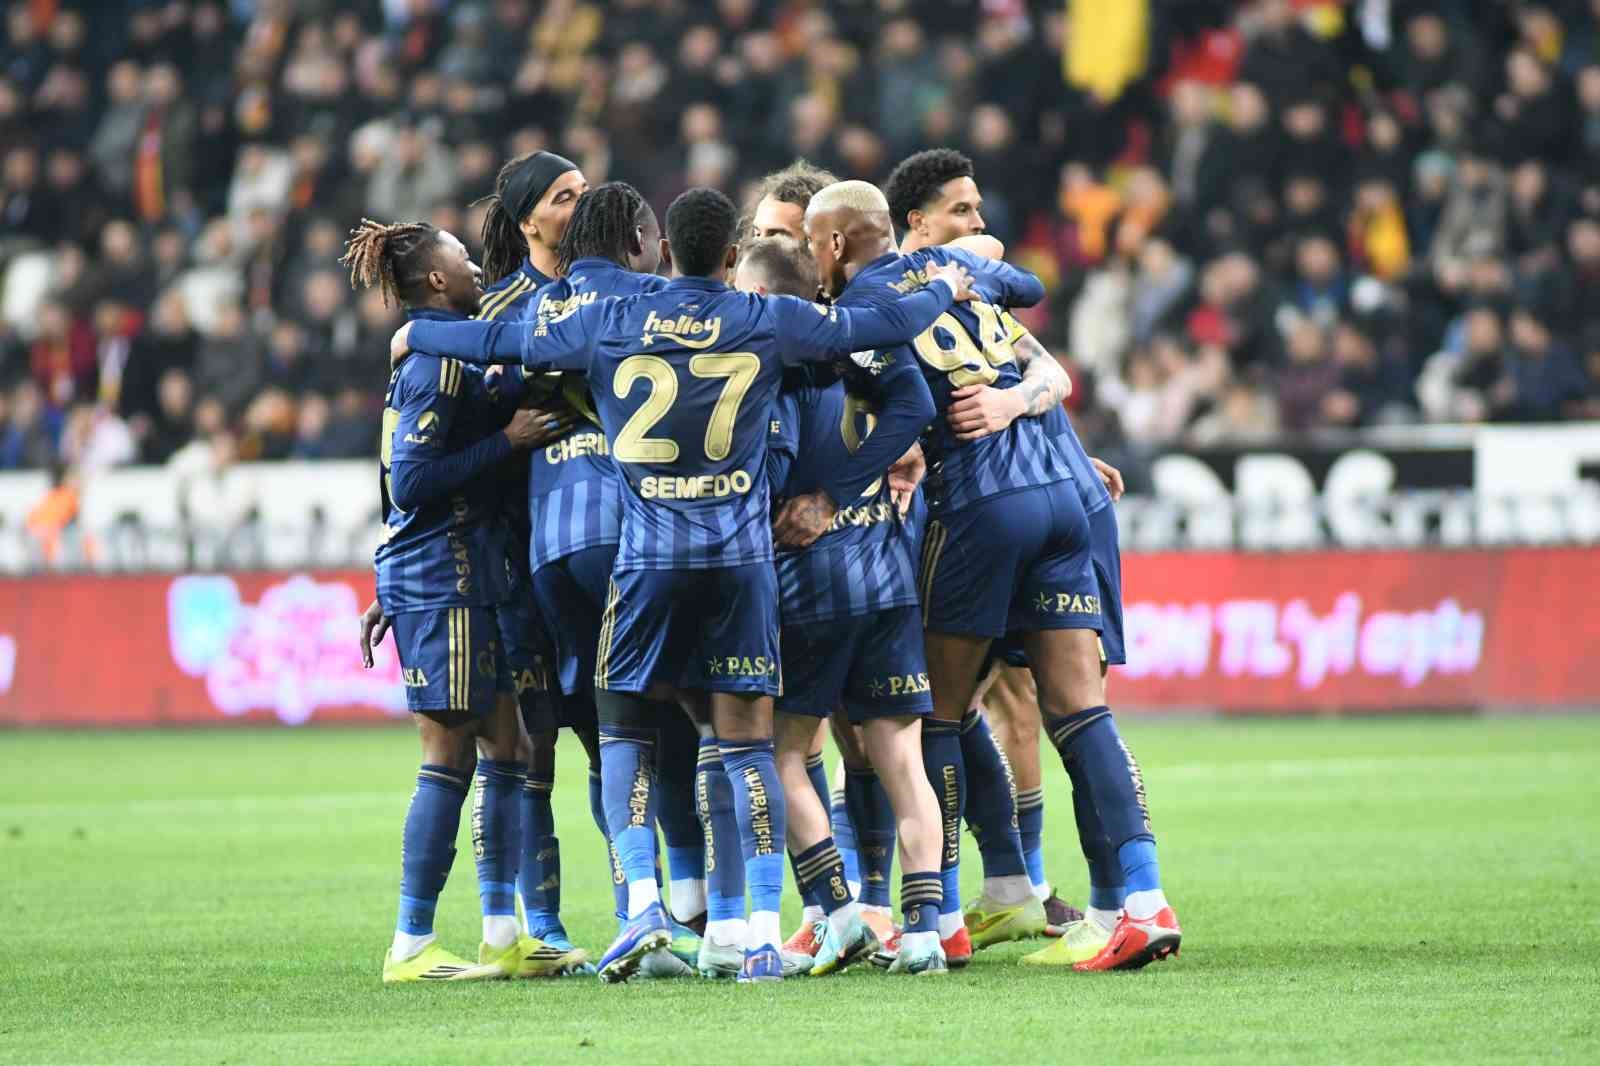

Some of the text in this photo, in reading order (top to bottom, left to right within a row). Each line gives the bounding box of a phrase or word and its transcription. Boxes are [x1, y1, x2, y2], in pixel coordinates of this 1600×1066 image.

[643, 310, 722, 349] halley
[913, 300, 1016, 388] 94
[613, 352, 761, 463] 27
[640, 470, 752, 499] SEMEDO
